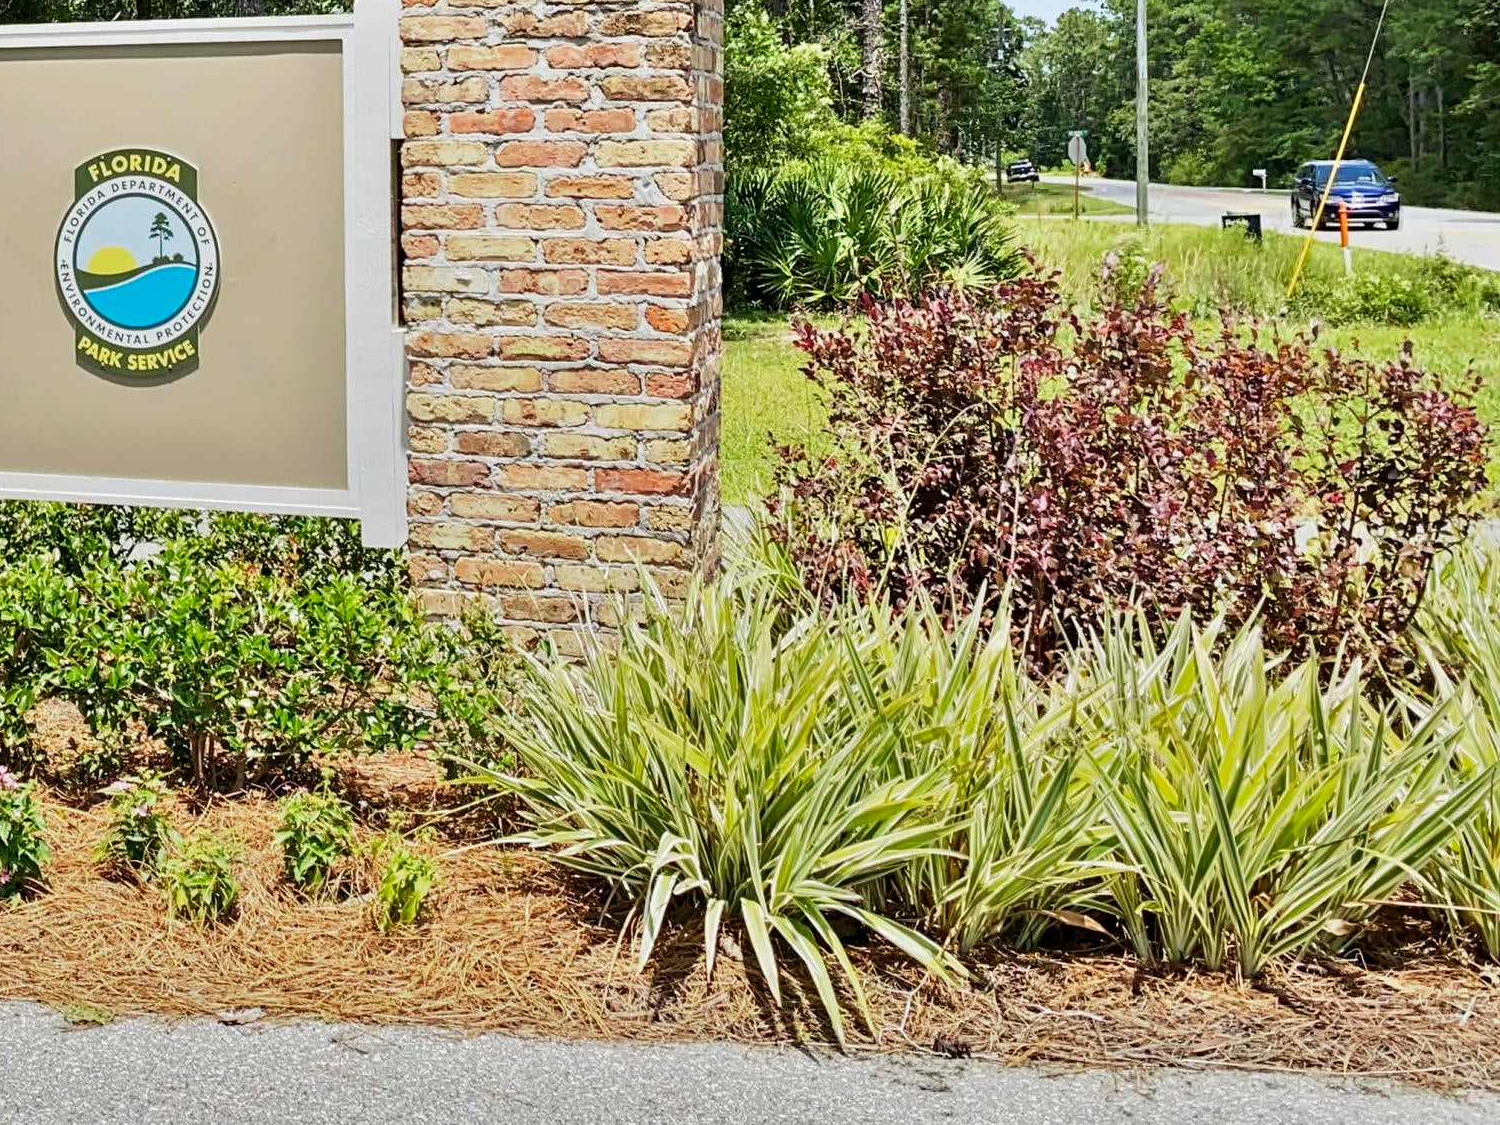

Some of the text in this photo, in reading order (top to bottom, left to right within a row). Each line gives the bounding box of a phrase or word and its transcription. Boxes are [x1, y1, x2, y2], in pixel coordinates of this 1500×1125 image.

[88, 154, 181, 183] FLORIDA
[64, 179, 211, 246] FLORIDA DEPARTMENT OF
[60, 263, 214, 345] ENVIRONMENTAL PROTECTION
[77, 336, 195, 371] PARK SERVICE
